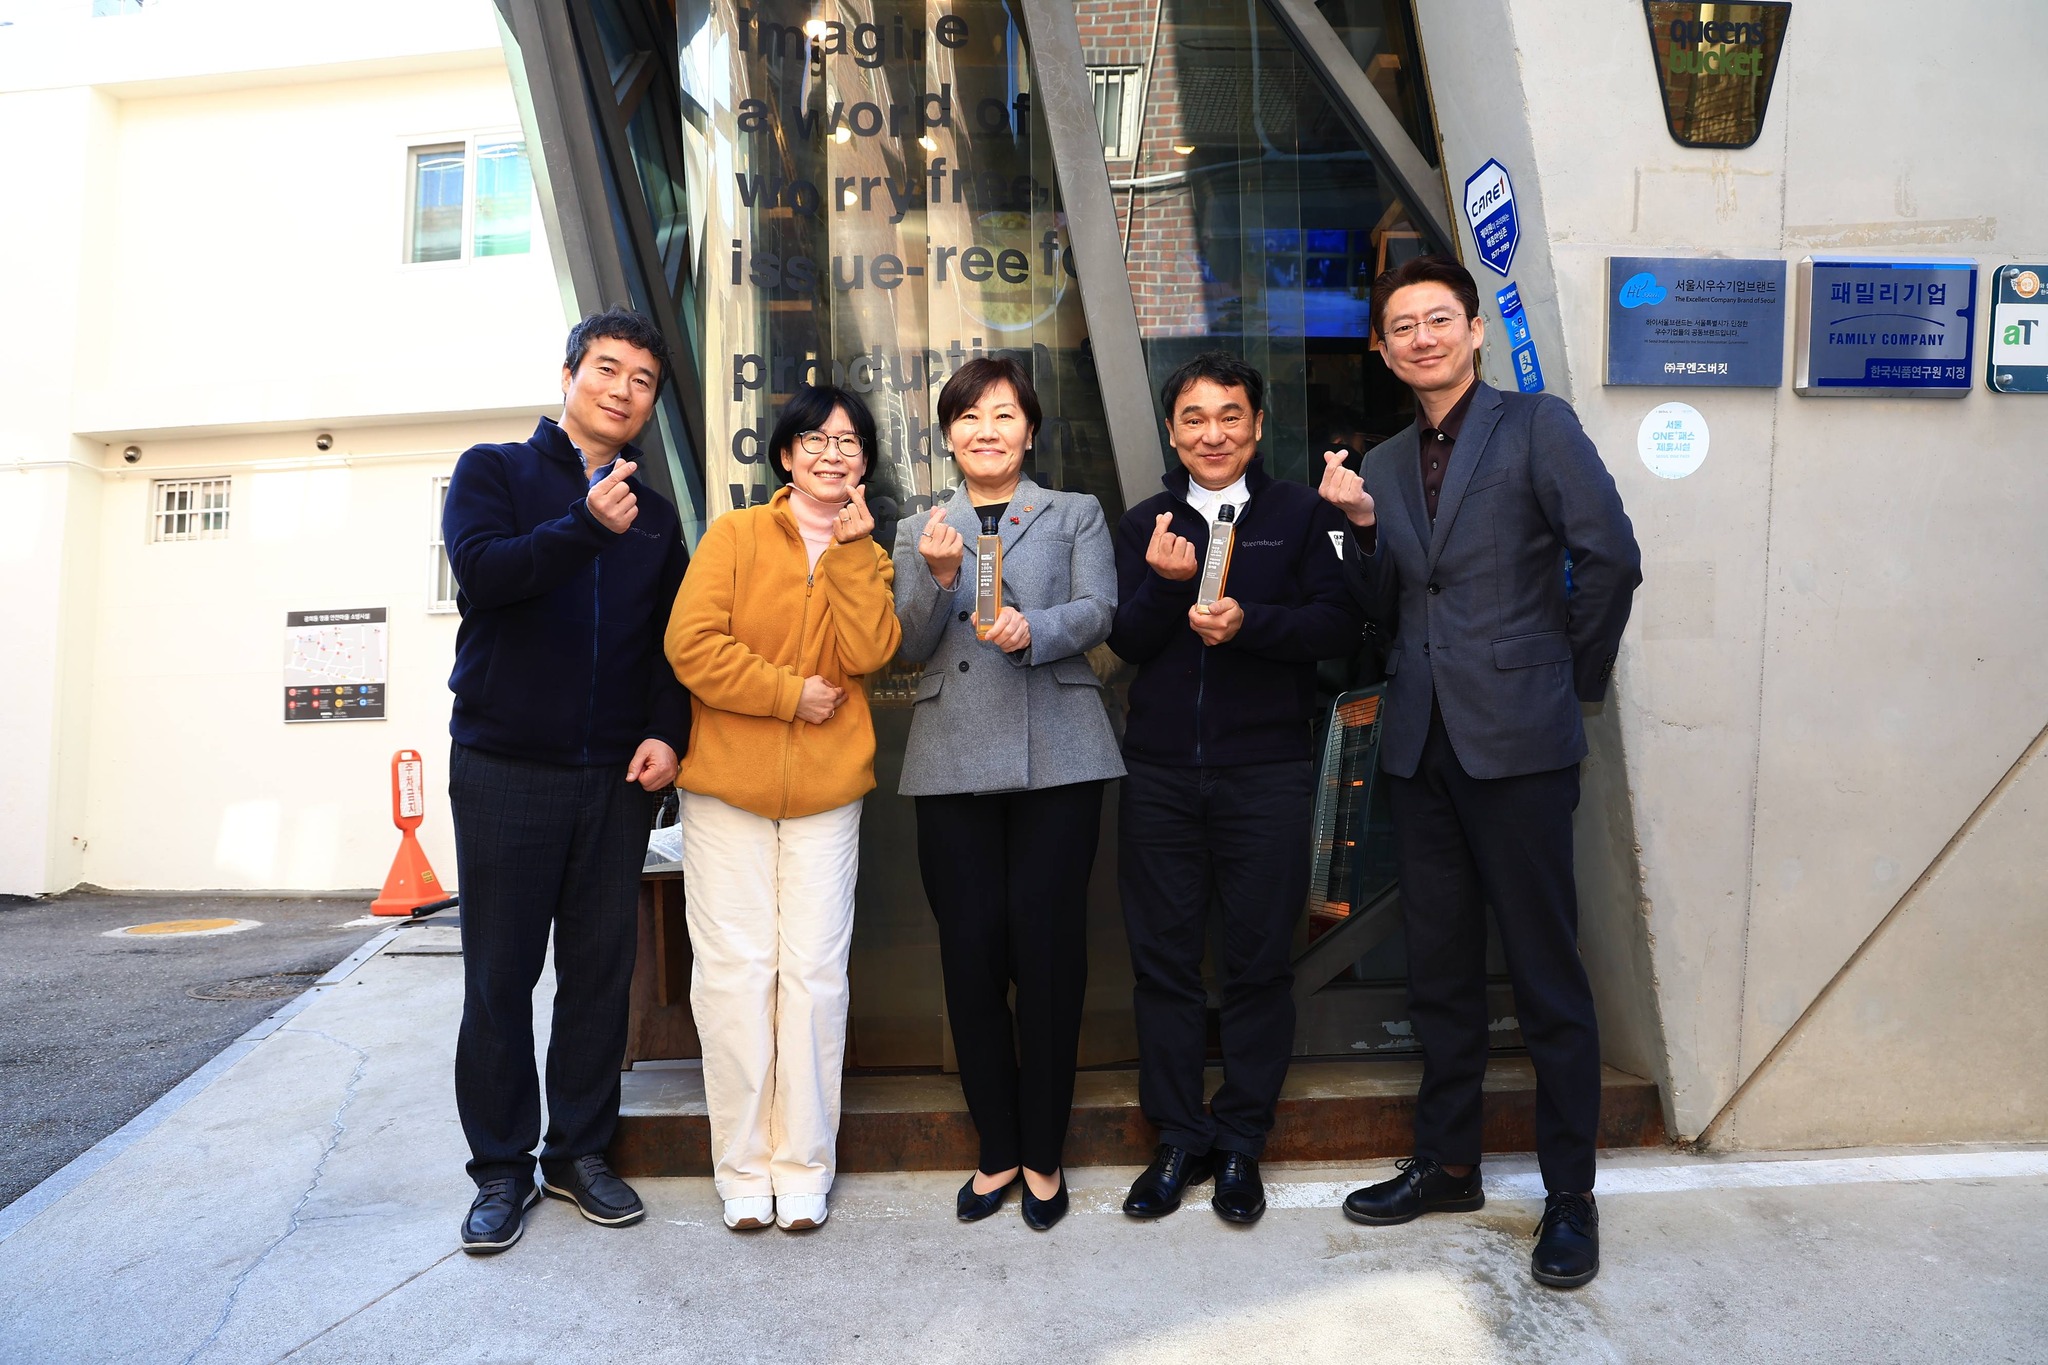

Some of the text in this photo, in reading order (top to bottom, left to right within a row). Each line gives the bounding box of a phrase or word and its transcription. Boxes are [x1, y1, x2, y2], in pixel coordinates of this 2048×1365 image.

[1670, 19, 1765, 50] queens
[1670, 43, 1764, 77] bucket
[738, 98, 769, 133] a
[976, 92, 1032, 136] of
[736, 171, 916, 225] worry
[1472, 175, 1505, 218] CARE1
[731, 235, 1030, 291] issue-ree
[1675, 279, 1777, 293] 서울시우수기업브랜드
[1831, 282, 1947, 305] 패밀리기업
[1711, 297, 1737, 305] Company
[1646, 319, 1749, 328] 하이서울브랜드는 서울특별시가 인정한
[1655, 328, 1690, 337] 우수기업들의
[2003, 319, 2039, 346] aT
[1829, 333, 1945, 346] FAMILY COMPANY
[1871, 366, 1966, 380] 한국식품연구원 지정
[1666, 420, 1682, 429] 서울
[1656, 443, 1691, 452] 제휴시설
